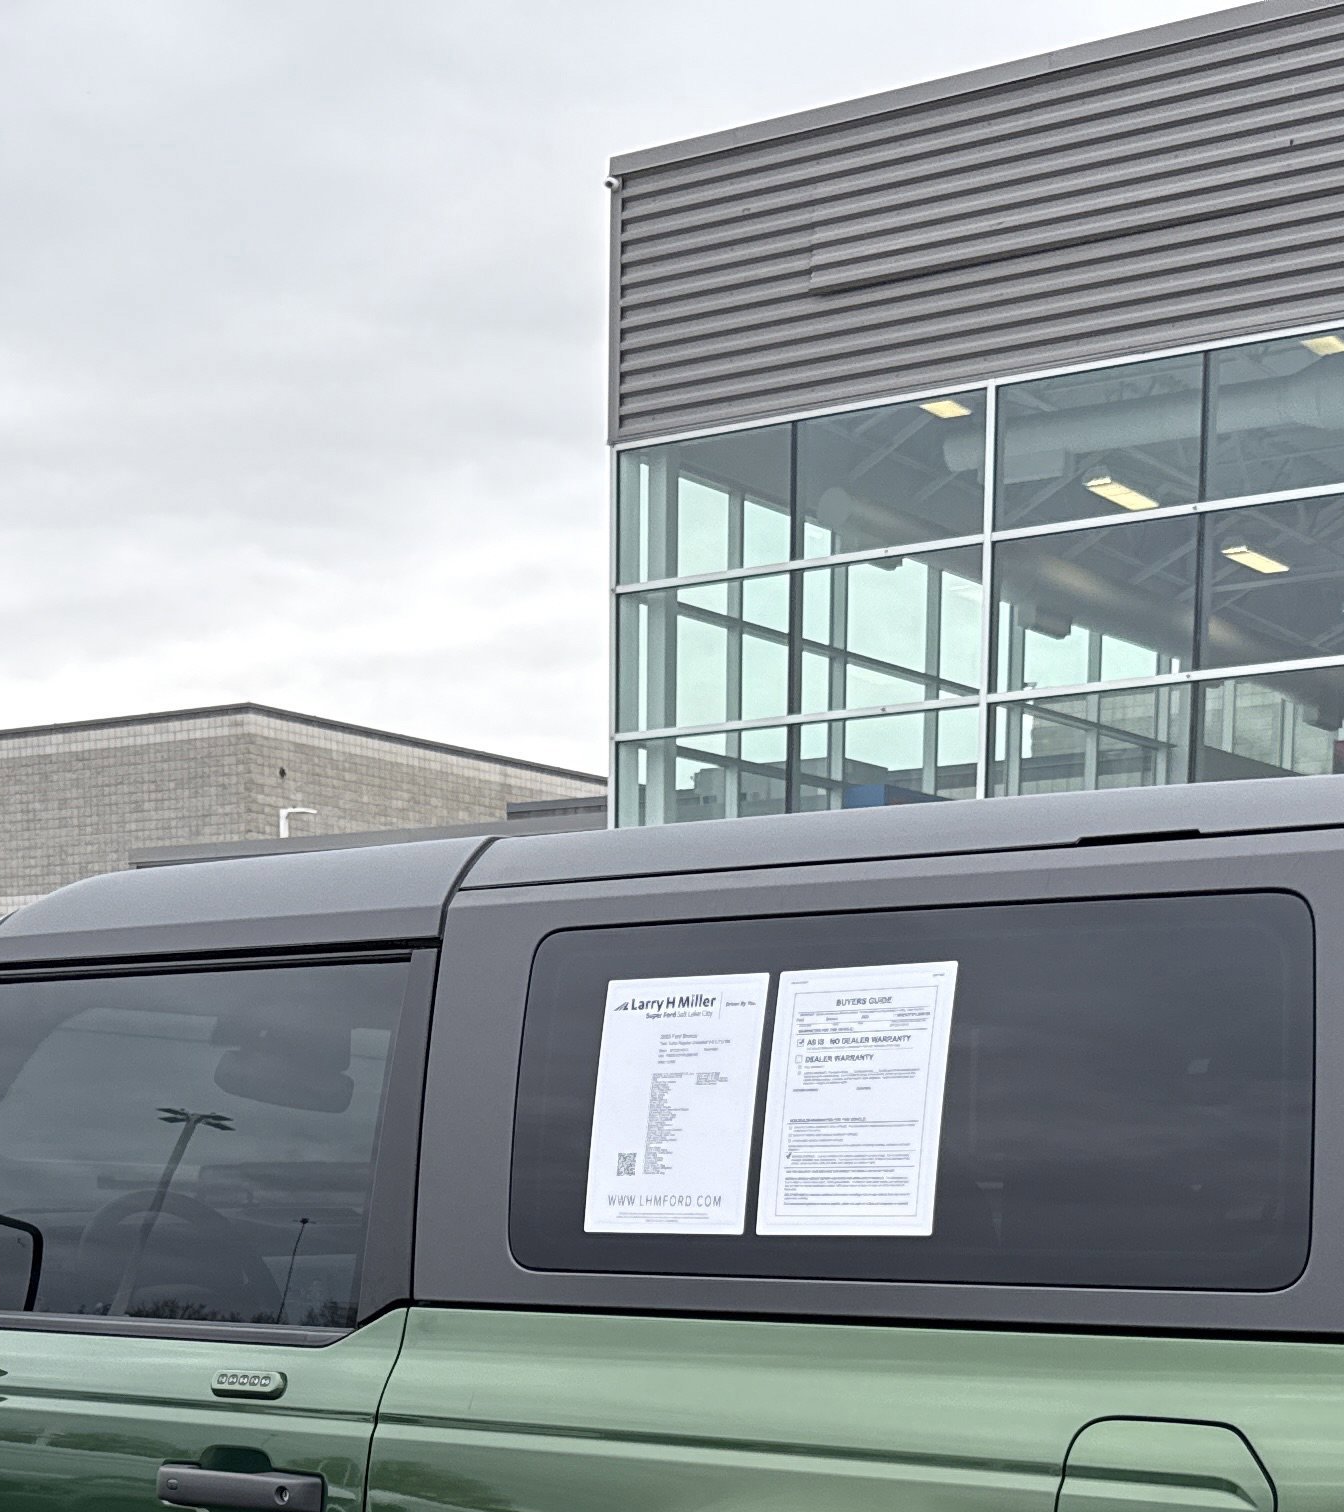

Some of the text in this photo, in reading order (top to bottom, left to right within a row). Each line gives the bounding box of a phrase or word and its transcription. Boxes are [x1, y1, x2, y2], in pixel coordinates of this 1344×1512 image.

[631, 994, 716, 1012] Larry H Miller
[836, 996, 892, 1007] BUYERS GUIDE
[702, 1010, 713, 1018] City
[807, 1038, 816, 1046] AS
[842, 1036, 869, 1045] DEALER
[871, 1034, 911, 1043] WARRANTY
[805, 1053, 874, 1063] DEALER WARRANTY
